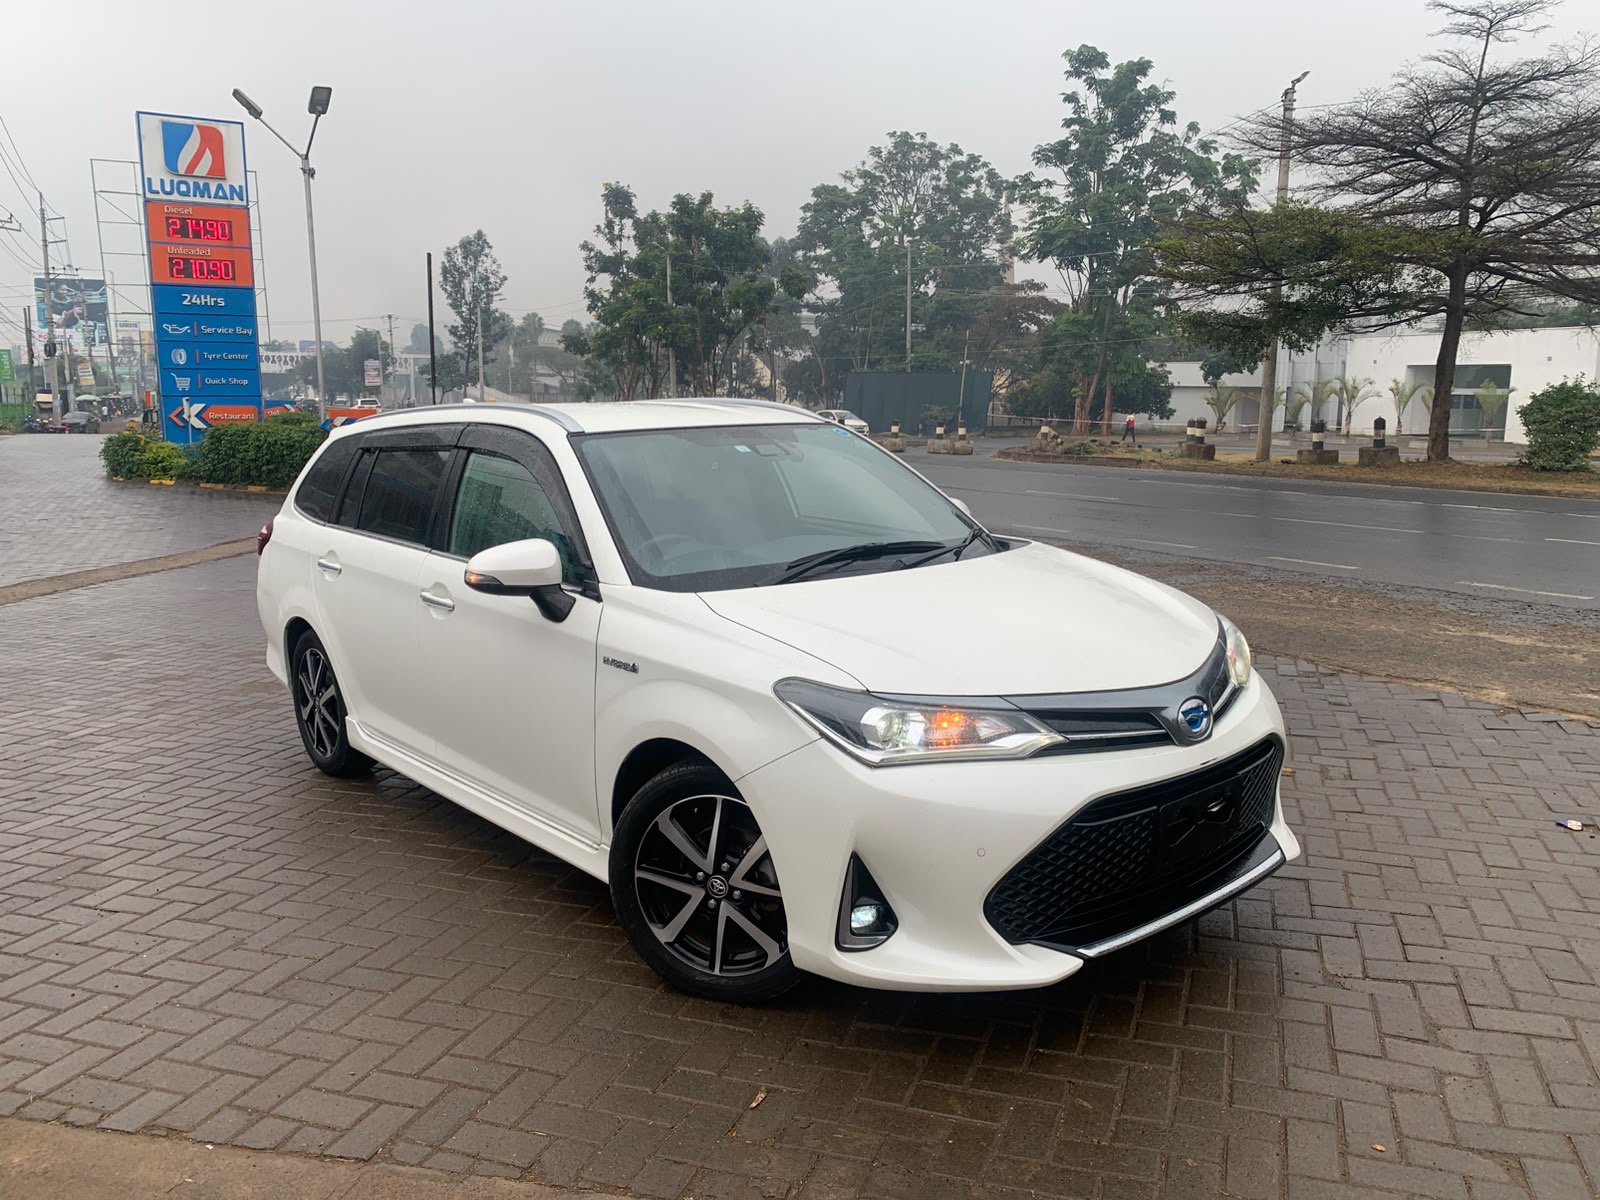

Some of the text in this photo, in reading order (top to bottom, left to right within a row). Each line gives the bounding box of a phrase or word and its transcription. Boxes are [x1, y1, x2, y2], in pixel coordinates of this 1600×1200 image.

[146, 177, 244, 202] LUQMAN
[164, 205, 193, 215] Diesel
[167, 246, 211, 256] Unleaded
[181, 293, 225, 307] 24Hrs
[201, 325, 253, 336] Service Bay
[203, 352, 221, 361] Tyre
[205, 377, 249, 386] Quick Shop
[208, 411, 255, 420] Restaurant
